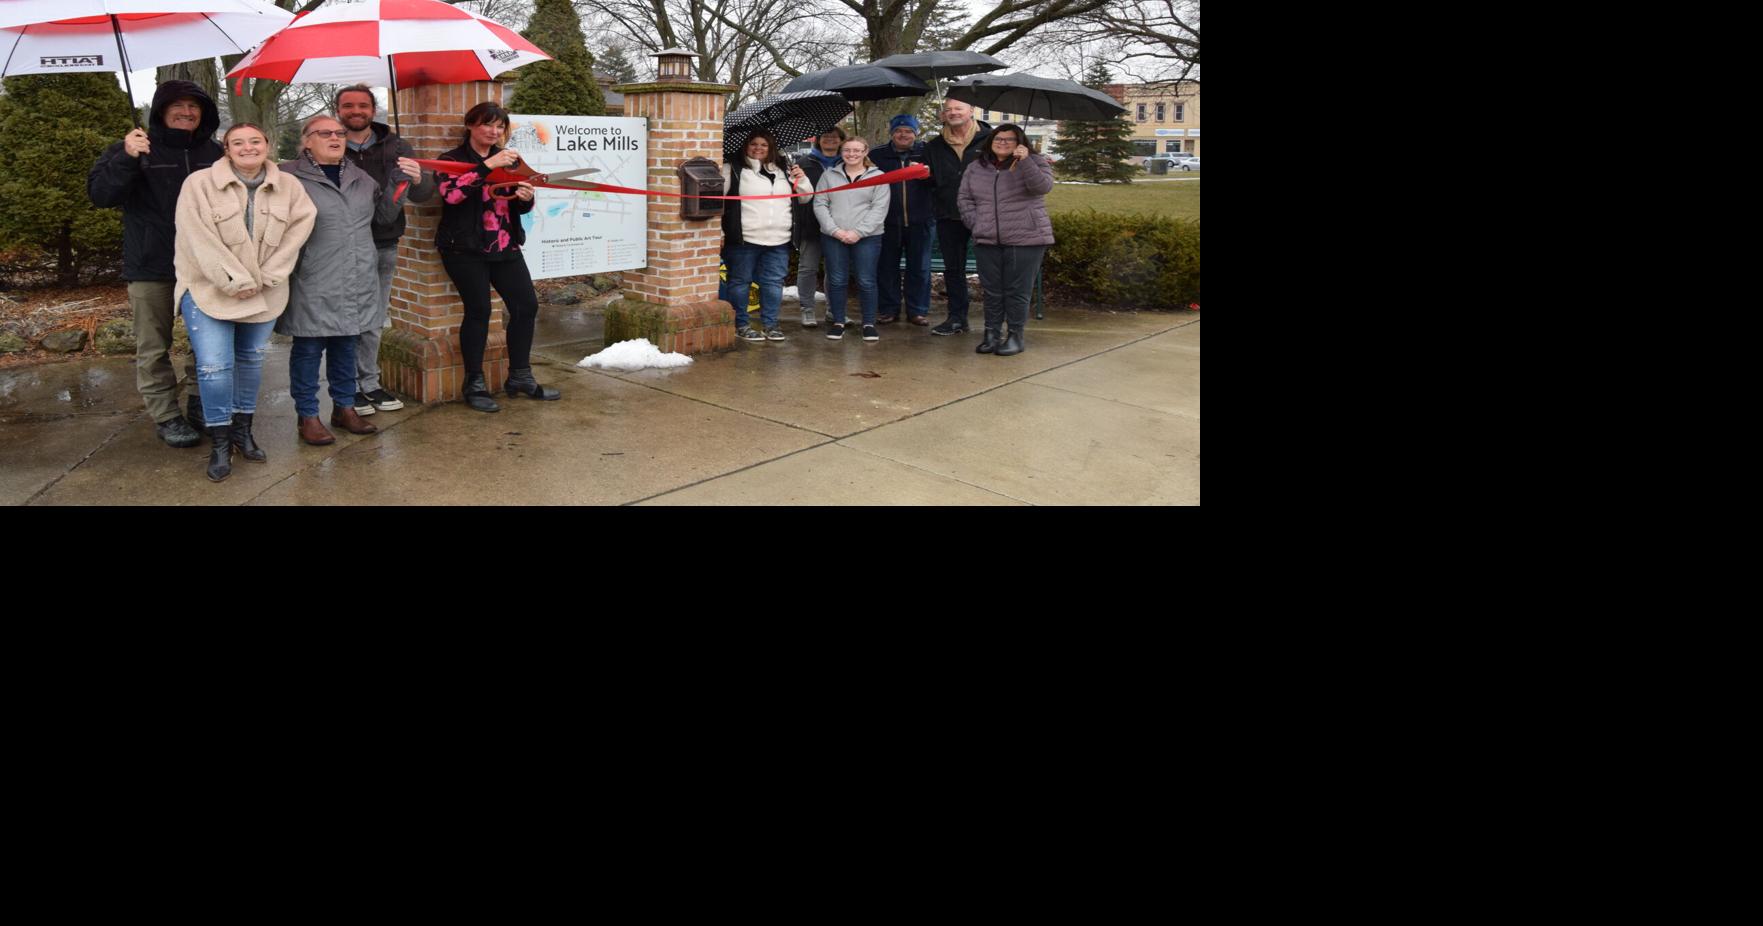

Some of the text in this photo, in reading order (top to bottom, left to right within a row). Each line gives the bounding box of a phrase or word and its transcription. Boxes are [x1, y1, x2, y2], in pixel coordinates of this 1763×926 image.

[555, 125, 622, 135] Welcome to
[556, 136, 597, 151] Lake
[603, 136, 639, 151] Mills
